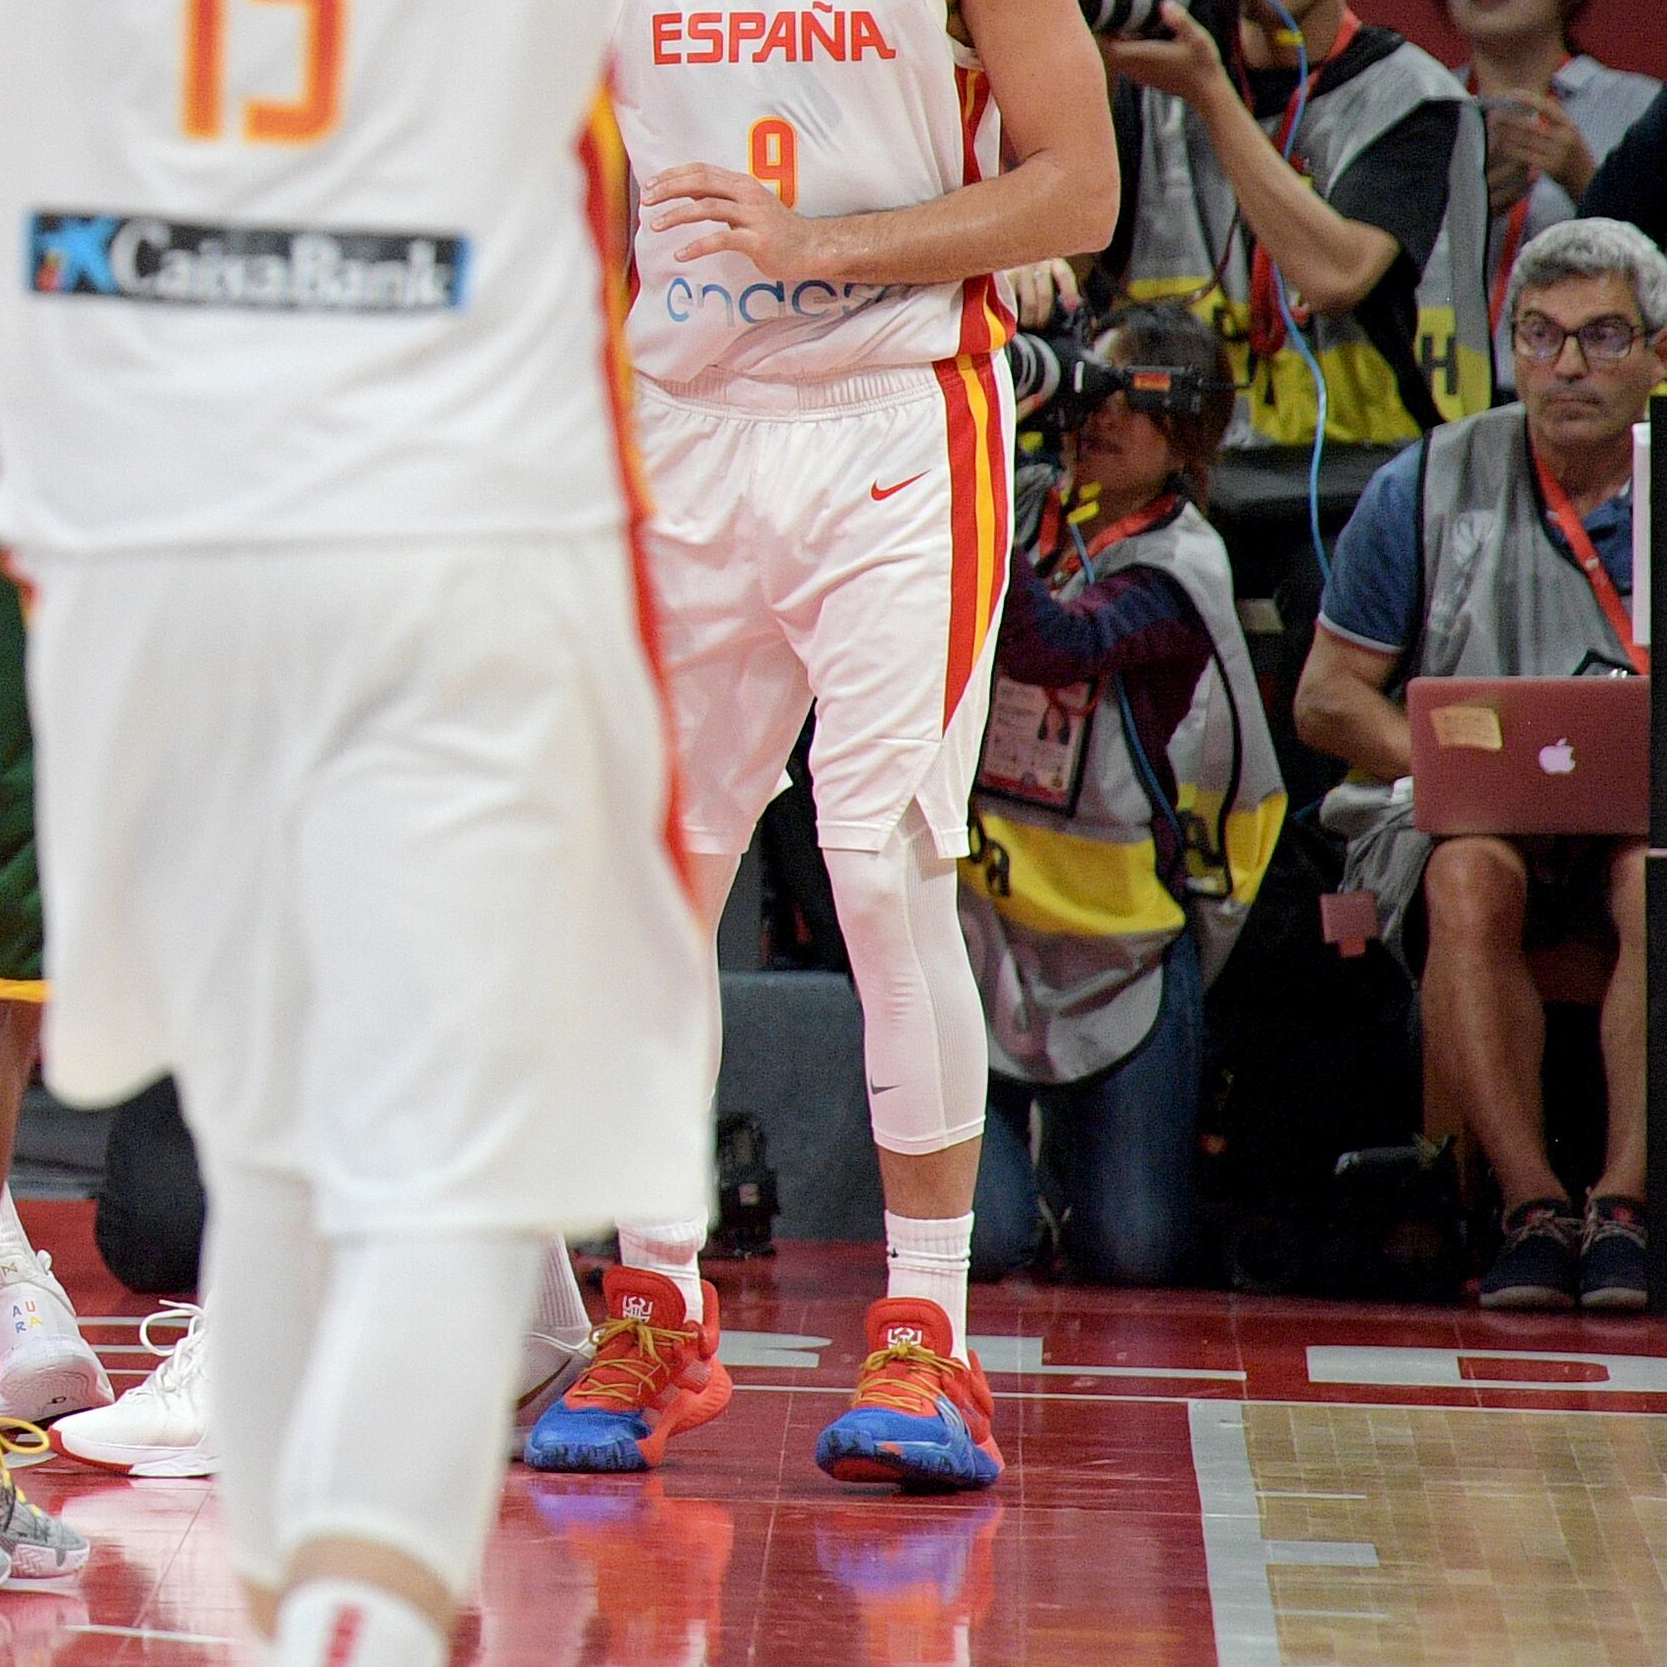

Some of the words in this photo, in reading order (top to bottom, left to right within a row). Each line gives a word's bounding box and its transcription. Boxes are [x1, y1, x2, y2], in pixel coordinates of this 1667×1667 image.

[652, 0, 898, 65] ESPAÑA
[747, 115, 799, 211] 9
[110, 217, 457, 309] CaixaBank
